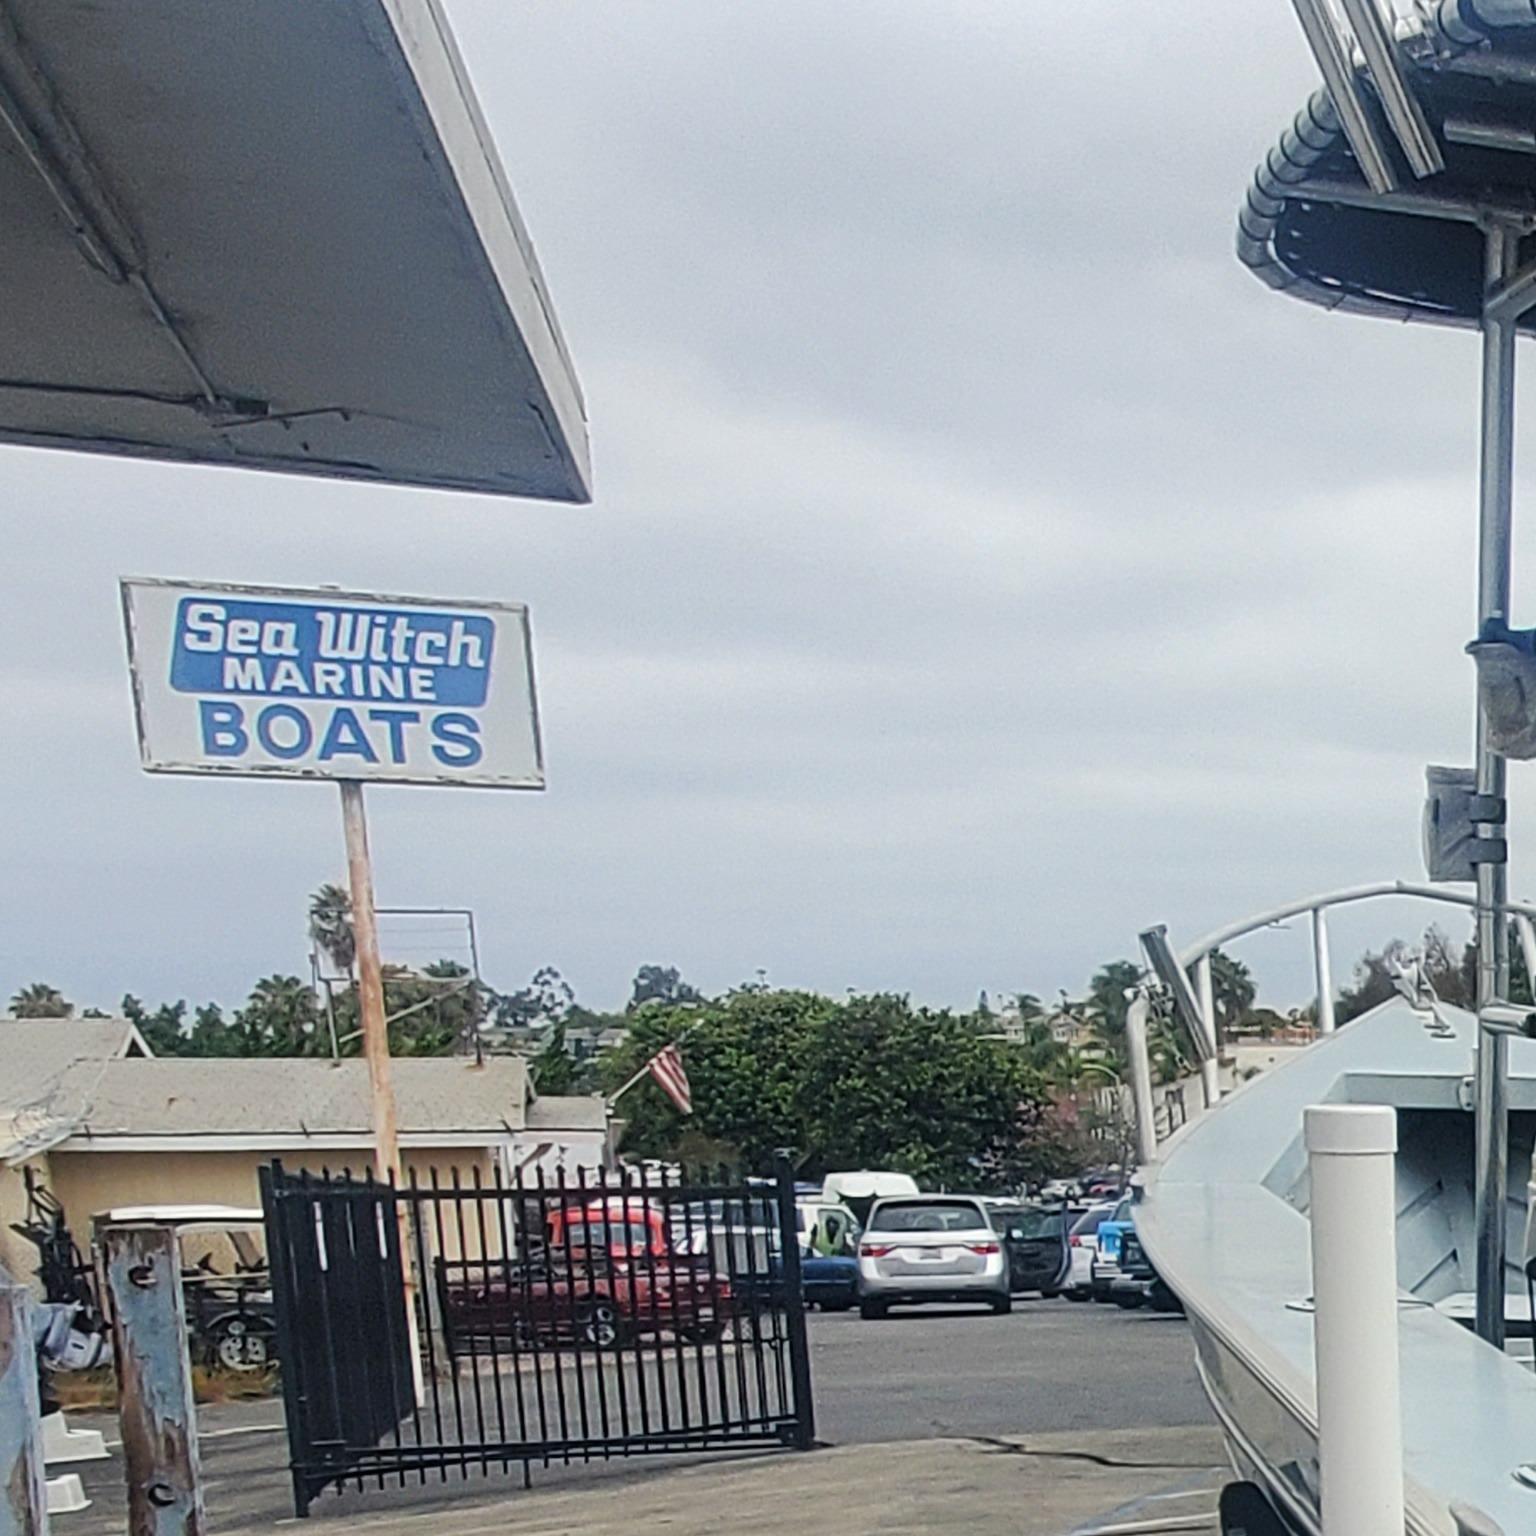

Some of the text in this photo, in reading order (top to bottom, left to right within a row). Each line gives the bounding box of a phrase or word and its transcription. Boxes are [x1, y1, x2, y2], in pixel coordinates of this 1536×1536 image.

[183, 603, 485, 668] Sea Witch
[222, 656, 438, 701] MARINE
[198, 699, 484, 768] BOATS
